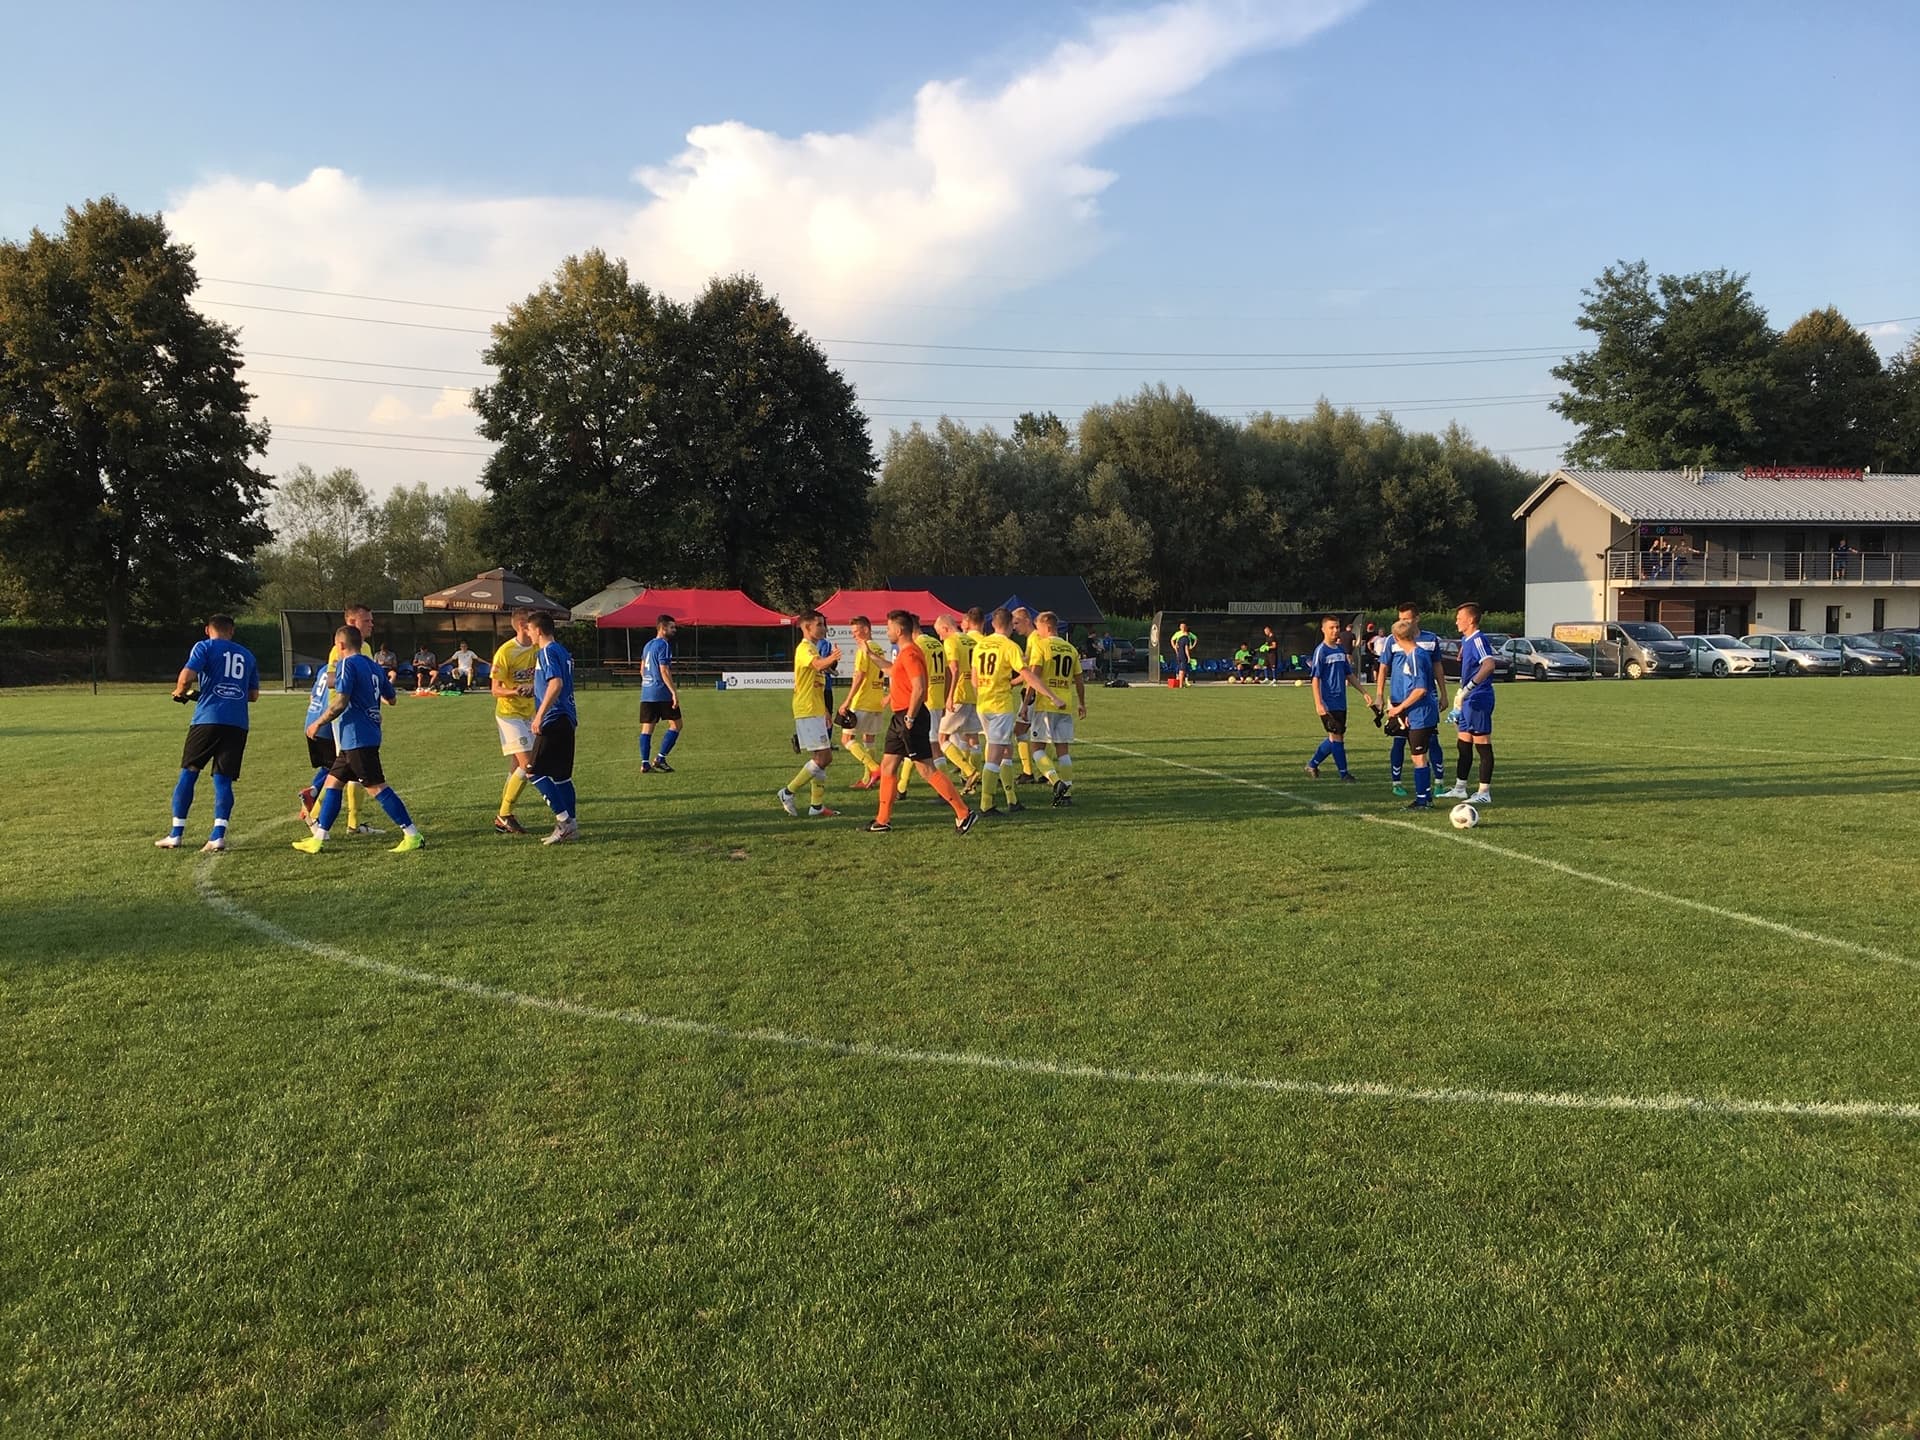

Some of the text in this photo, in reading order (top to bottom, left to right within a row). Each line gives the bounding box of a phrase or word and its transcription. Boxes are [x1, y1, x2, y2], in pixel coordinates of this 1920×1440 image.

[223, 651, 245, 680] 16
[644, 651, 651, 671] 4
[931, 651, 944, 673] 11
[978, 652, 997, 675] 18
[1052, 654, 1073, 678] 10
